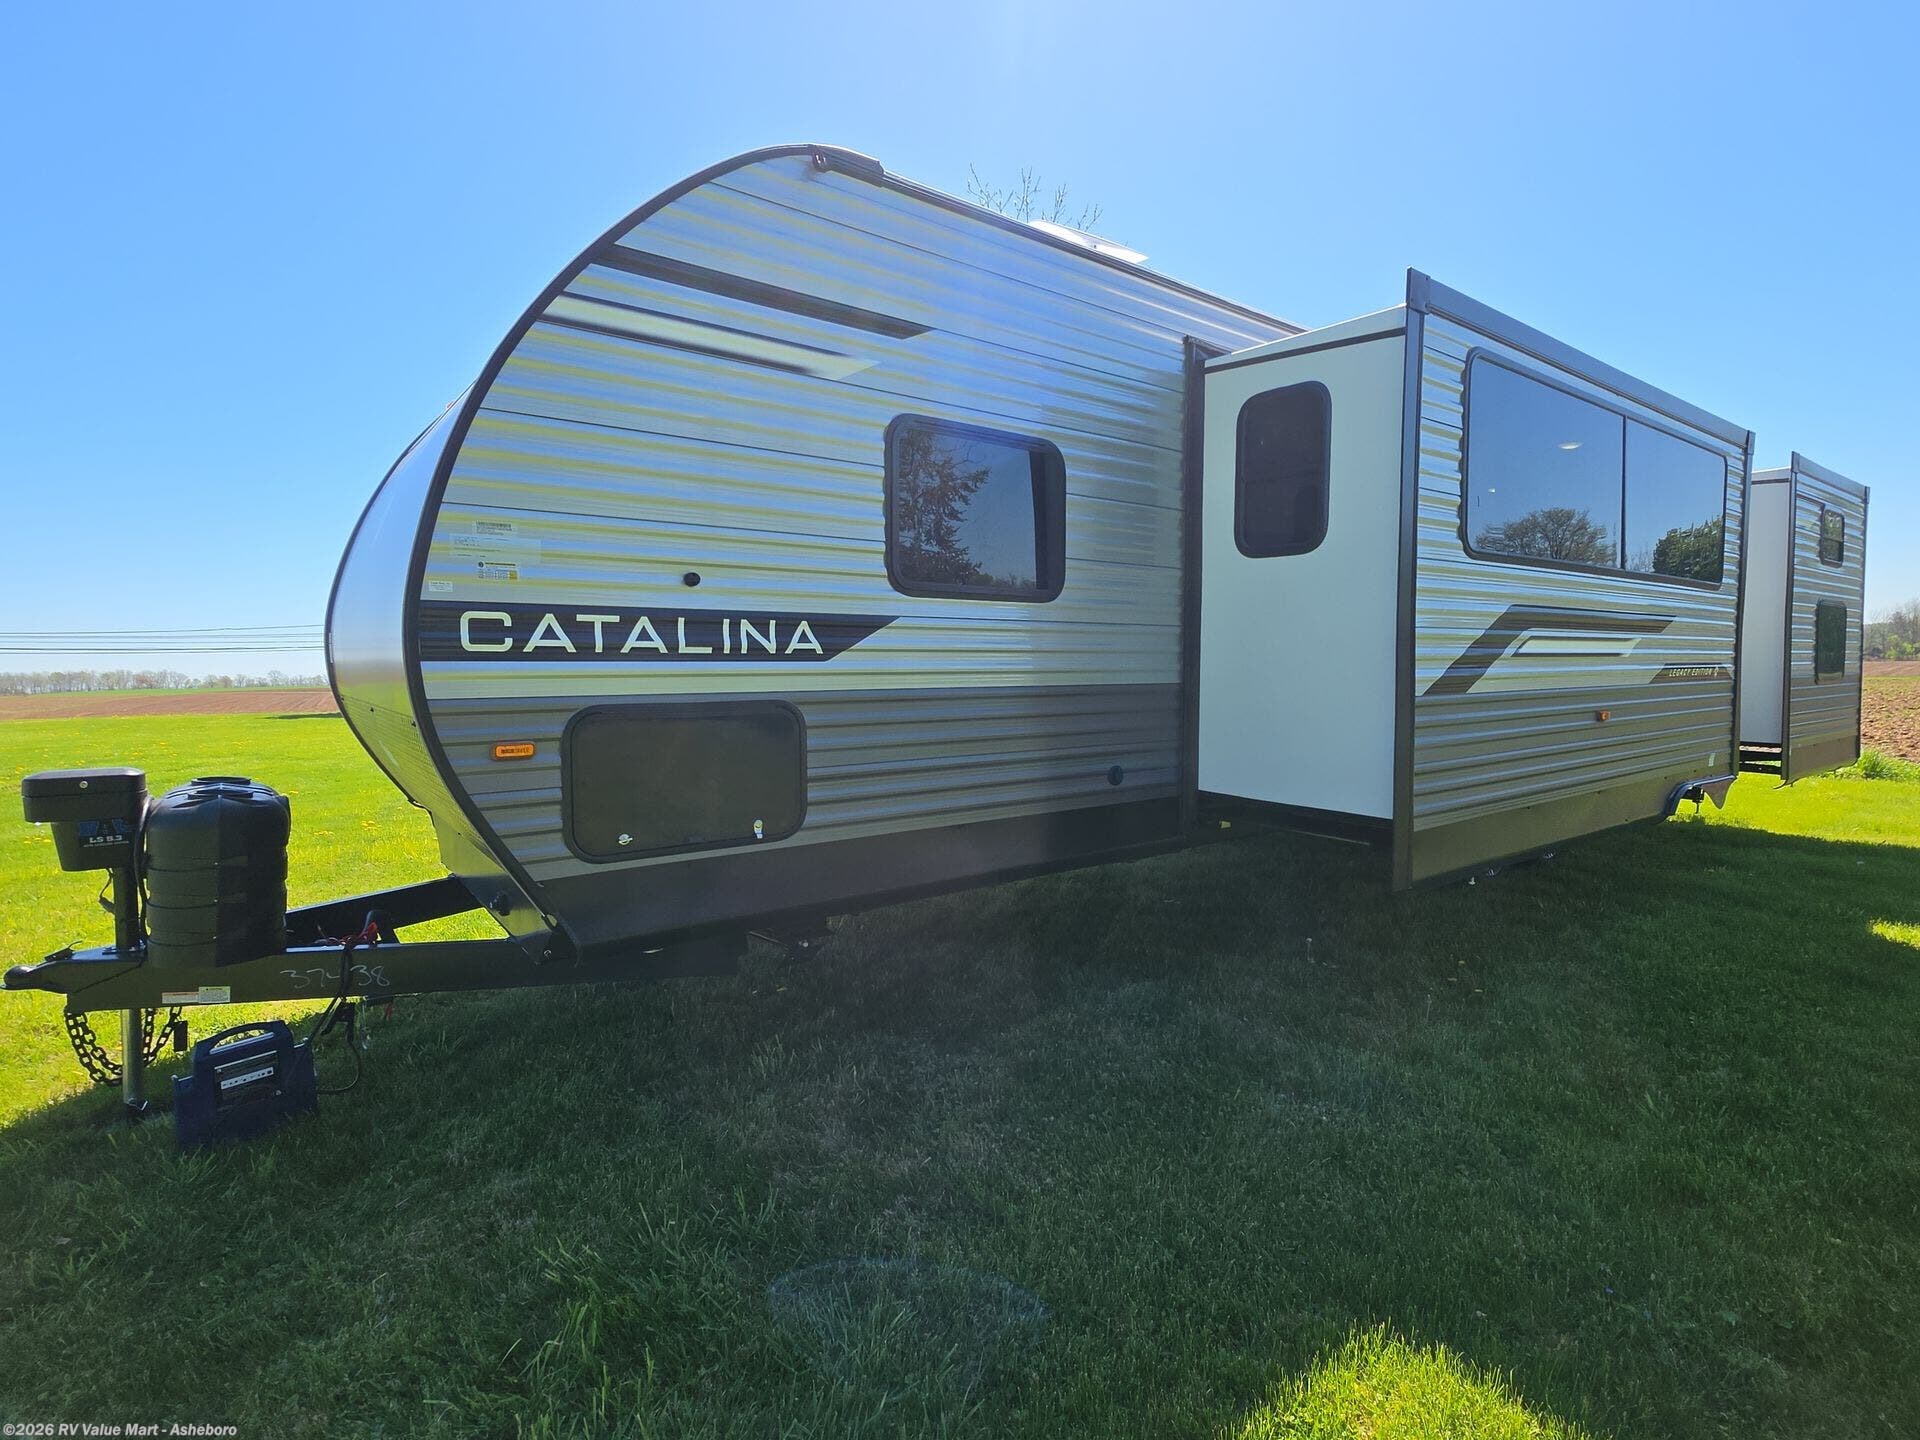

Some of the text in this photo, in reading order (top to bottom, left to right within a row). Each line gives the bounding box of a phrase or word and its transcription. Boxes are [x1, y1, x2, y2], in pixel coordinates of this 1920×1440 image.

[459, 610, 824, 655] CATALINA
[1668, 667, 1712, 677] LEGACY EDITION
